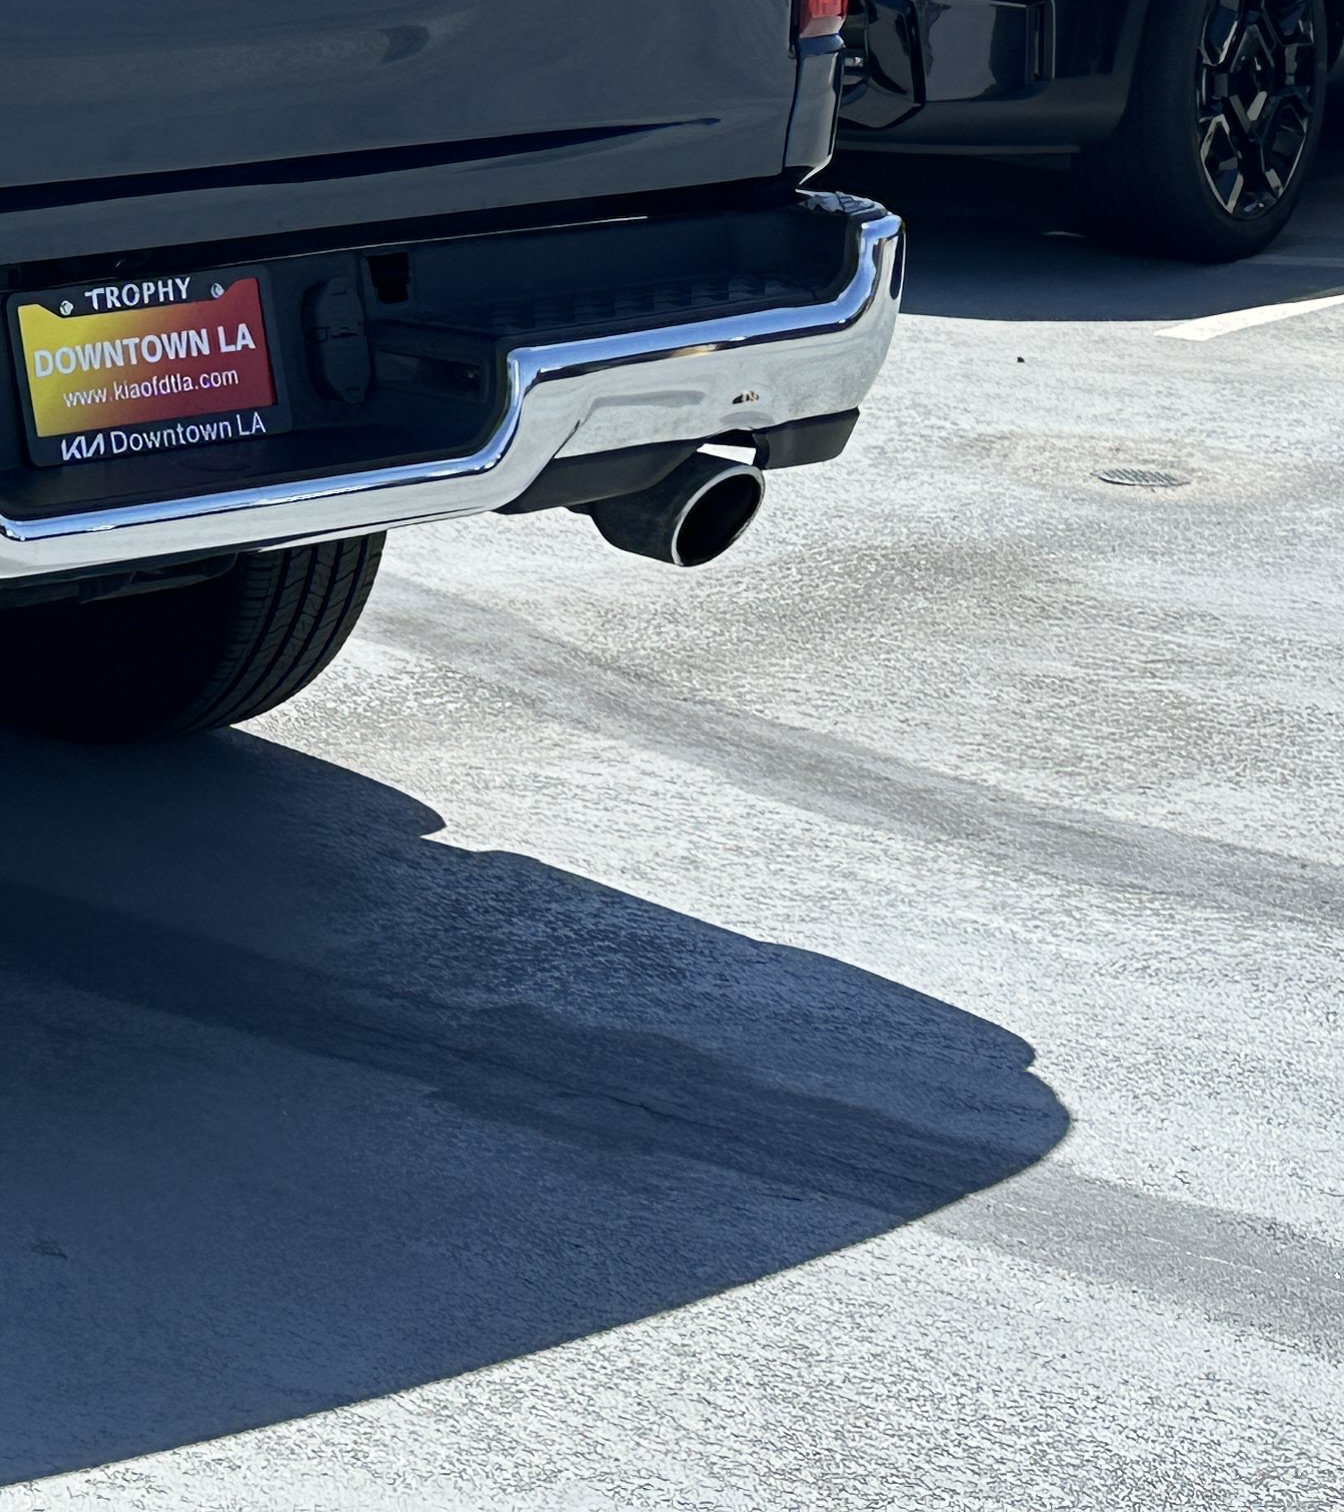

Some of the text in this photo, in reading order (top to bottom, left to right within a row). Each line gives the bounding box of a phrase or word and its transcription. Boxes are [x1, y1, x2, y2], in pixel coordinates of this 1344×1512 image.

[84, 277, 191, 310] TROPHY
[33, 322, 256, 378] DOWNTOWN LA
[63, 368, 239, 407] www.kiaofdtla.com
[62, 411, 266, 461] KIA Downtown LA
